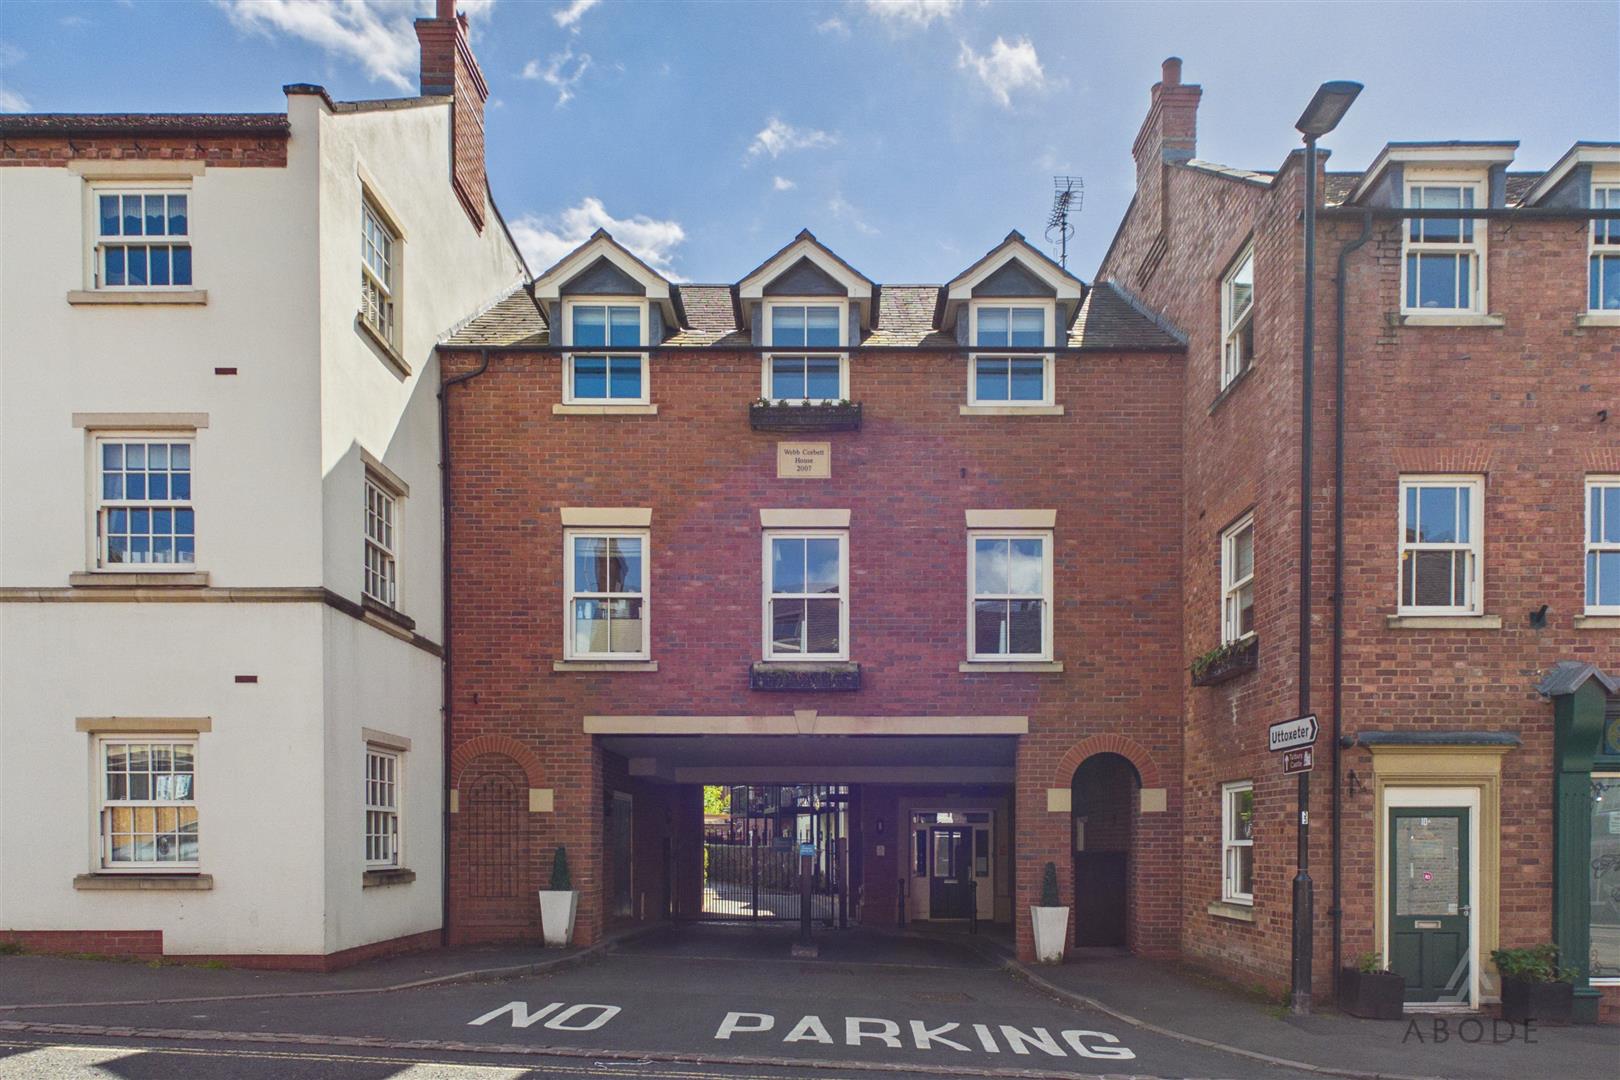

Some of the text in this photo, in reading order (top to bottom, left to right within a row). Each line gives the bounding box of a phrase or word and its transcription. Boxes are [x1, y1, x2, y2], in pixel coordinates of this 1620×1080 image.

[1271, 726, 1310, 744] Uttoxeter
[467, 1001, 1136, 1060] NO PARKING
